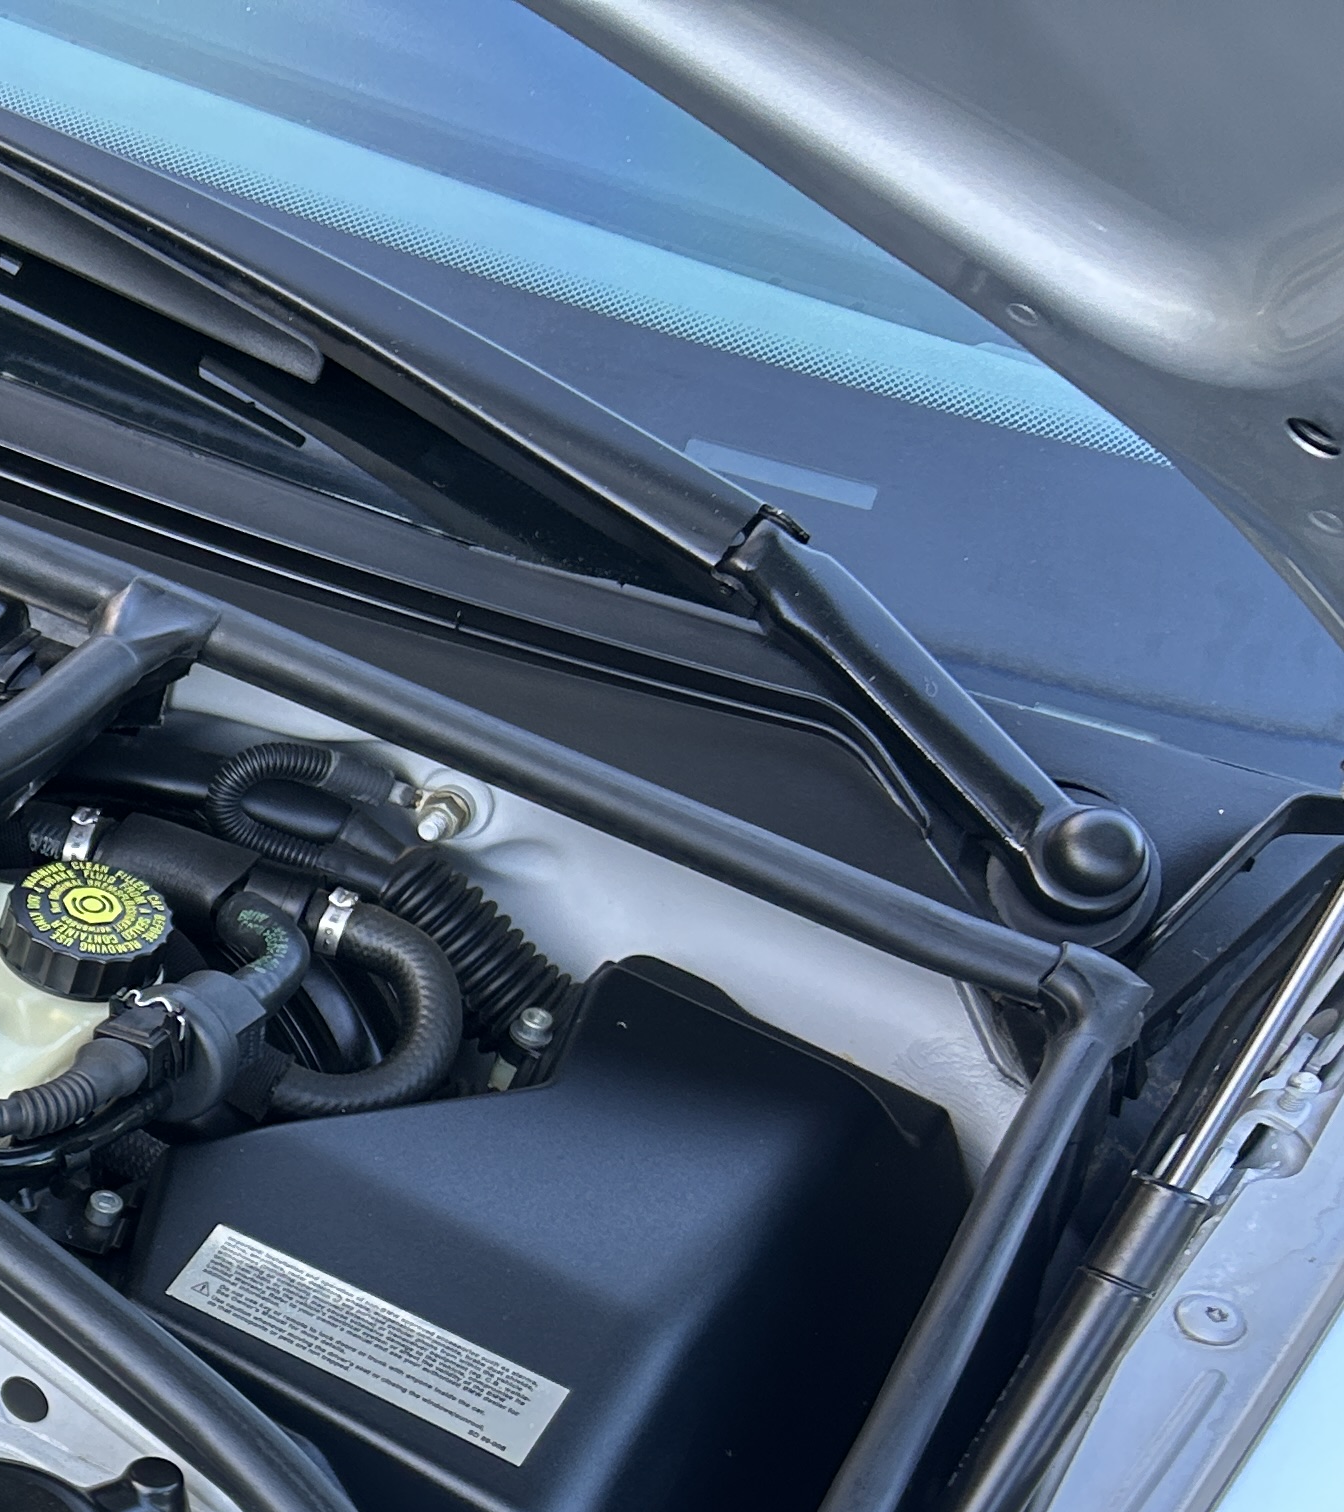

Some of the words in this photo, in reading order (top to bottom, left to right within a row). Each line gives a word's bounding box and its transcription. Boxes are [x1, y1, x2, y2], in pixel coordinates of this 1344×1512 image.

[72, 861, 109, 874] CLEAN
[83, 869, 117, 884] FLUID
[114, 871, 149, 893] FILLER
[146, 895, 164, 911] CAP
[29, 912, 53, 931] ONLY
[49, 930, 74, 946] USE
[50, 920, 119, 945] CONTAINER
[80, 940, 141, 953] REMOVING
